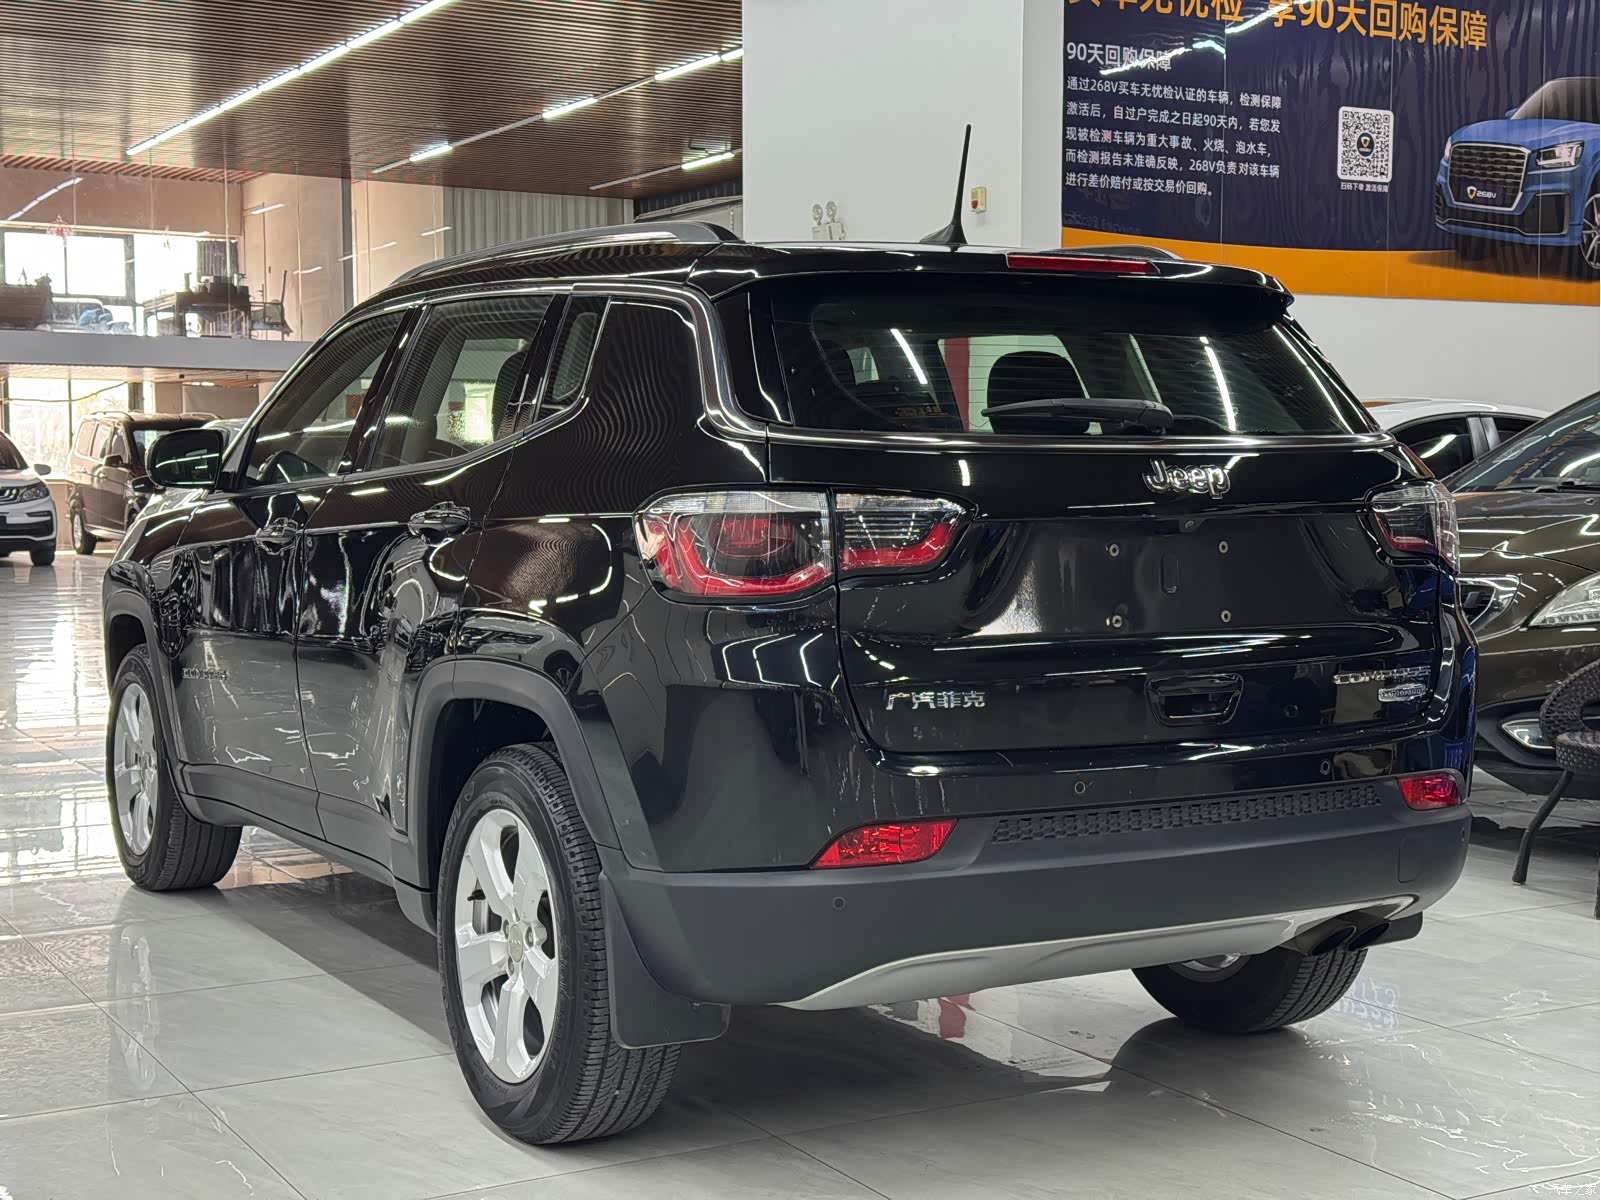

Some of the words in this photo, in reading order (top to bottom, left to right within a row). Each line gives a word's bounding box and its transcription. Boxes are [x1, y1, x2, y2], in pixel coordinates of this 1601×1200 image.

[1476, 190, 1497, 199] 268V
[1142, 458, 1231, 499] Jeep
[885, 690, 986, 711] 广汽菲克
